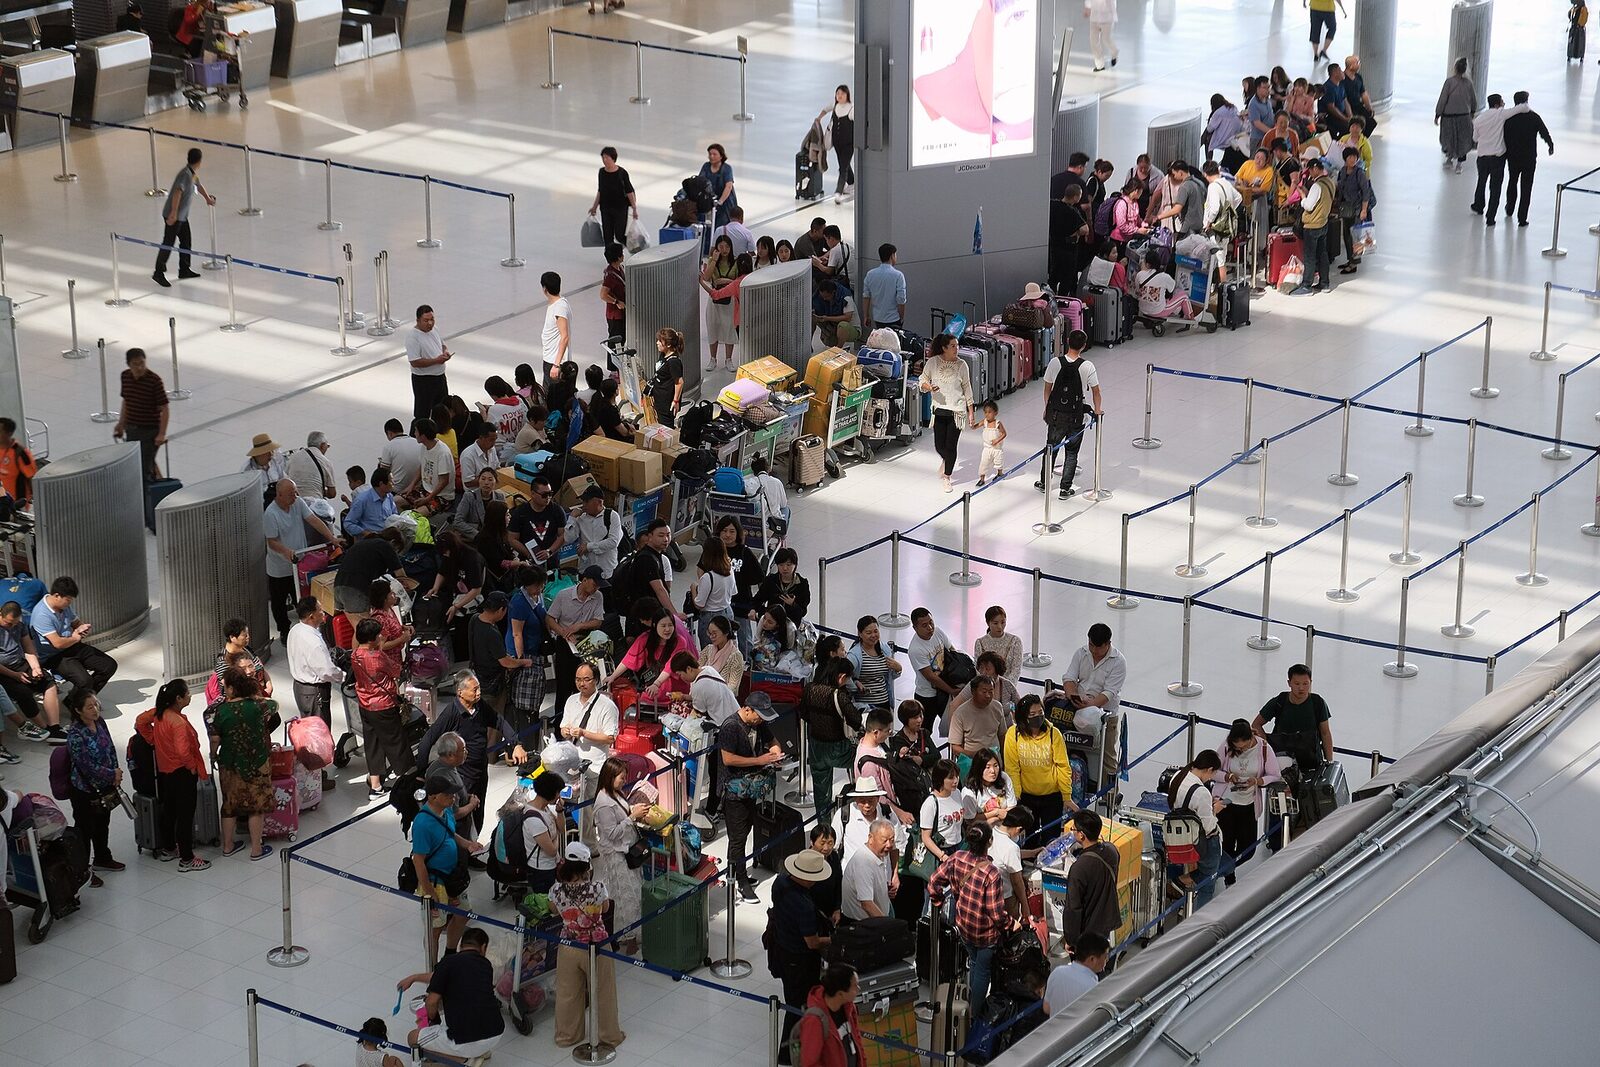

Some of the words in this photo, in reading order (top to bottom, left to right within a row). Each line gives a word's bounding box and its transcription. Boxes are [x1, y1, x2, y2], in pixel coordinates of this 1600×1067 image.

[958, 163, 987, 171] JCDecaux
[1051, 706, 1075, 723] 图途
[1020, 751, 1051, 760] SUNDAY
[1020, 759, 1051, 768] SUNDAY
[297, 856, 309, 864] AOT
[466, 912, 479, 920] AOT
[633, 960, 646, 968] AOT
[681, 974, 693, 983] AOT
[729, 989, 742, 997] AOT
[335, 1025, 347, 1033] AOT
[863, 1032, 876, 1040] AOT
[381, 1040, 393, 1048] AOT
[915, 1048, 927, 1056] AOT
